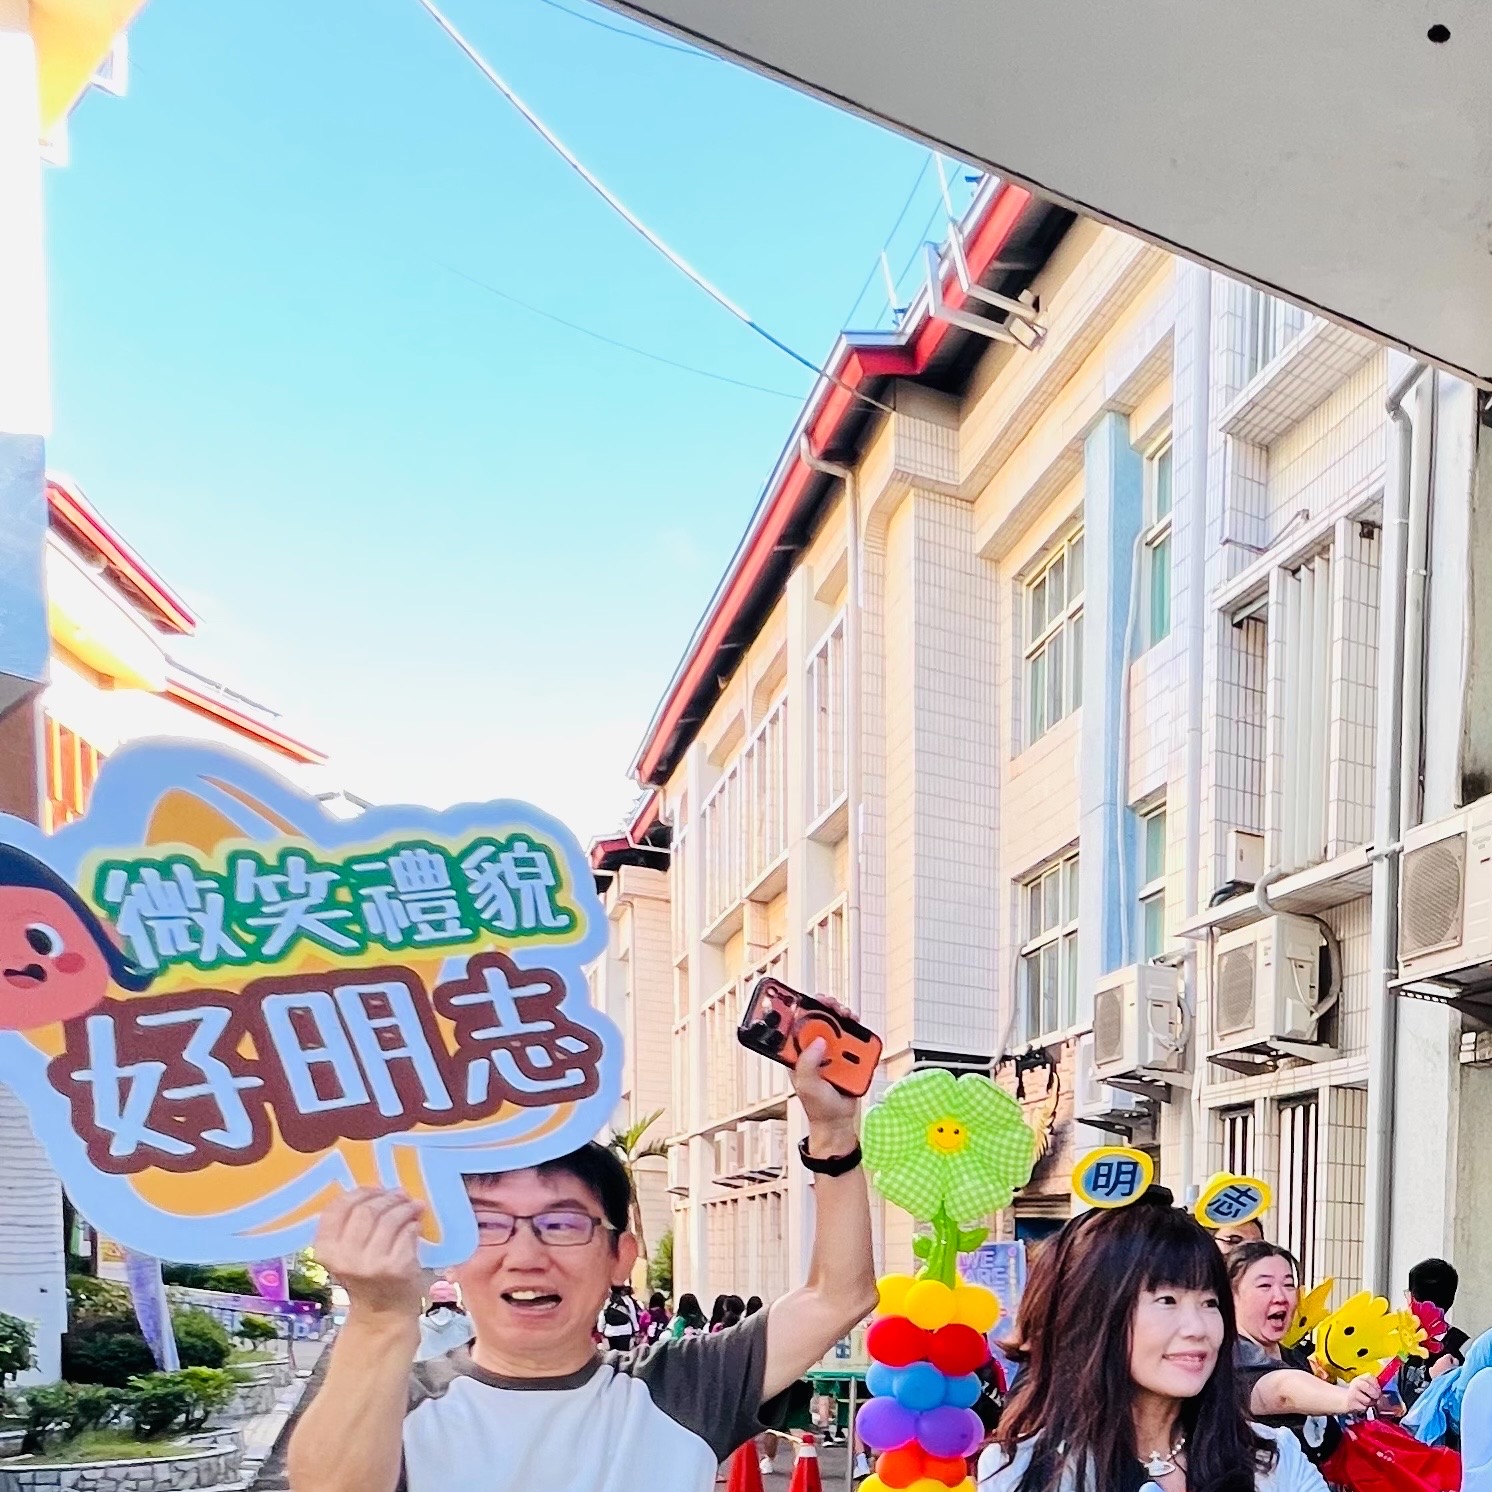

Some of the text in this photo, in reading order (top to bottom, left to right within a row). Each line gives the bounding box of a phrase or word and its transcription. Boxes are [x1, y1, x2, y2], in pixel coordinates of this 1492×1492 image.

[101, 838, 573, 972] 微笑禮貌
[69, 964, 590, 1159] 好明志
[1091, 1160, 1140, 1197] 明
[1208, 1184, 1258, 1219] 志
[959, 1250, 996, 1269] WE
